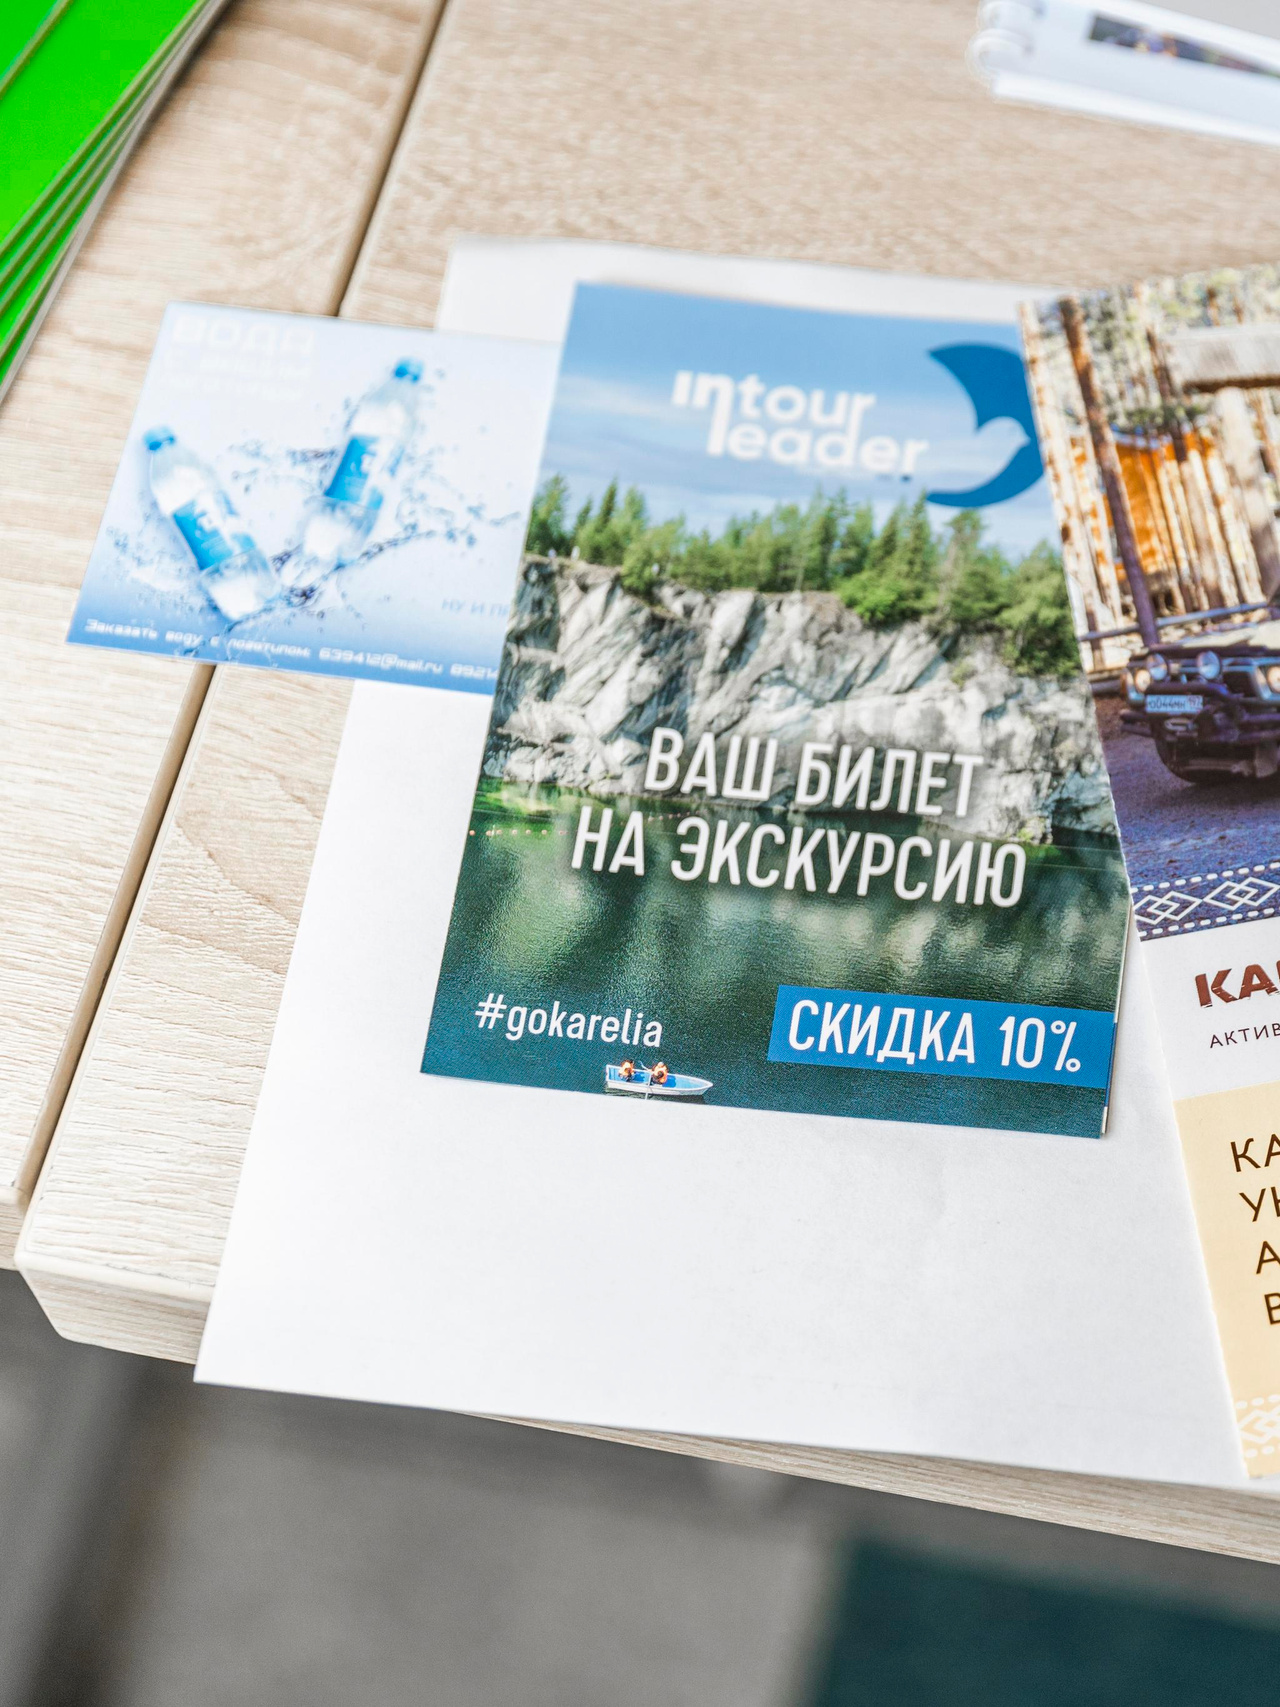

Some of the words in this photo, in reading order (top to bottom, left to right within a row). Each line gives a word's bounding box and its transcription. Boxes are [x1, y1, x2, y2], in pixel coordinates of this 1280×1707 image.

[85, 618, 158, 640] Заказать
[644, 726, 778, 801] ВАШ
[797, 742, 984, 818] БИЛЕТ
[571, 805, 646, 876] НА
[671, 816, 1027, 908] ЭКСКУРСИЮ
[474, 993, 663, 1048] #gokarelia
[789, 998, 976, 1065] СКИДКА
[999, 1016, 1082, 1073] 10%
